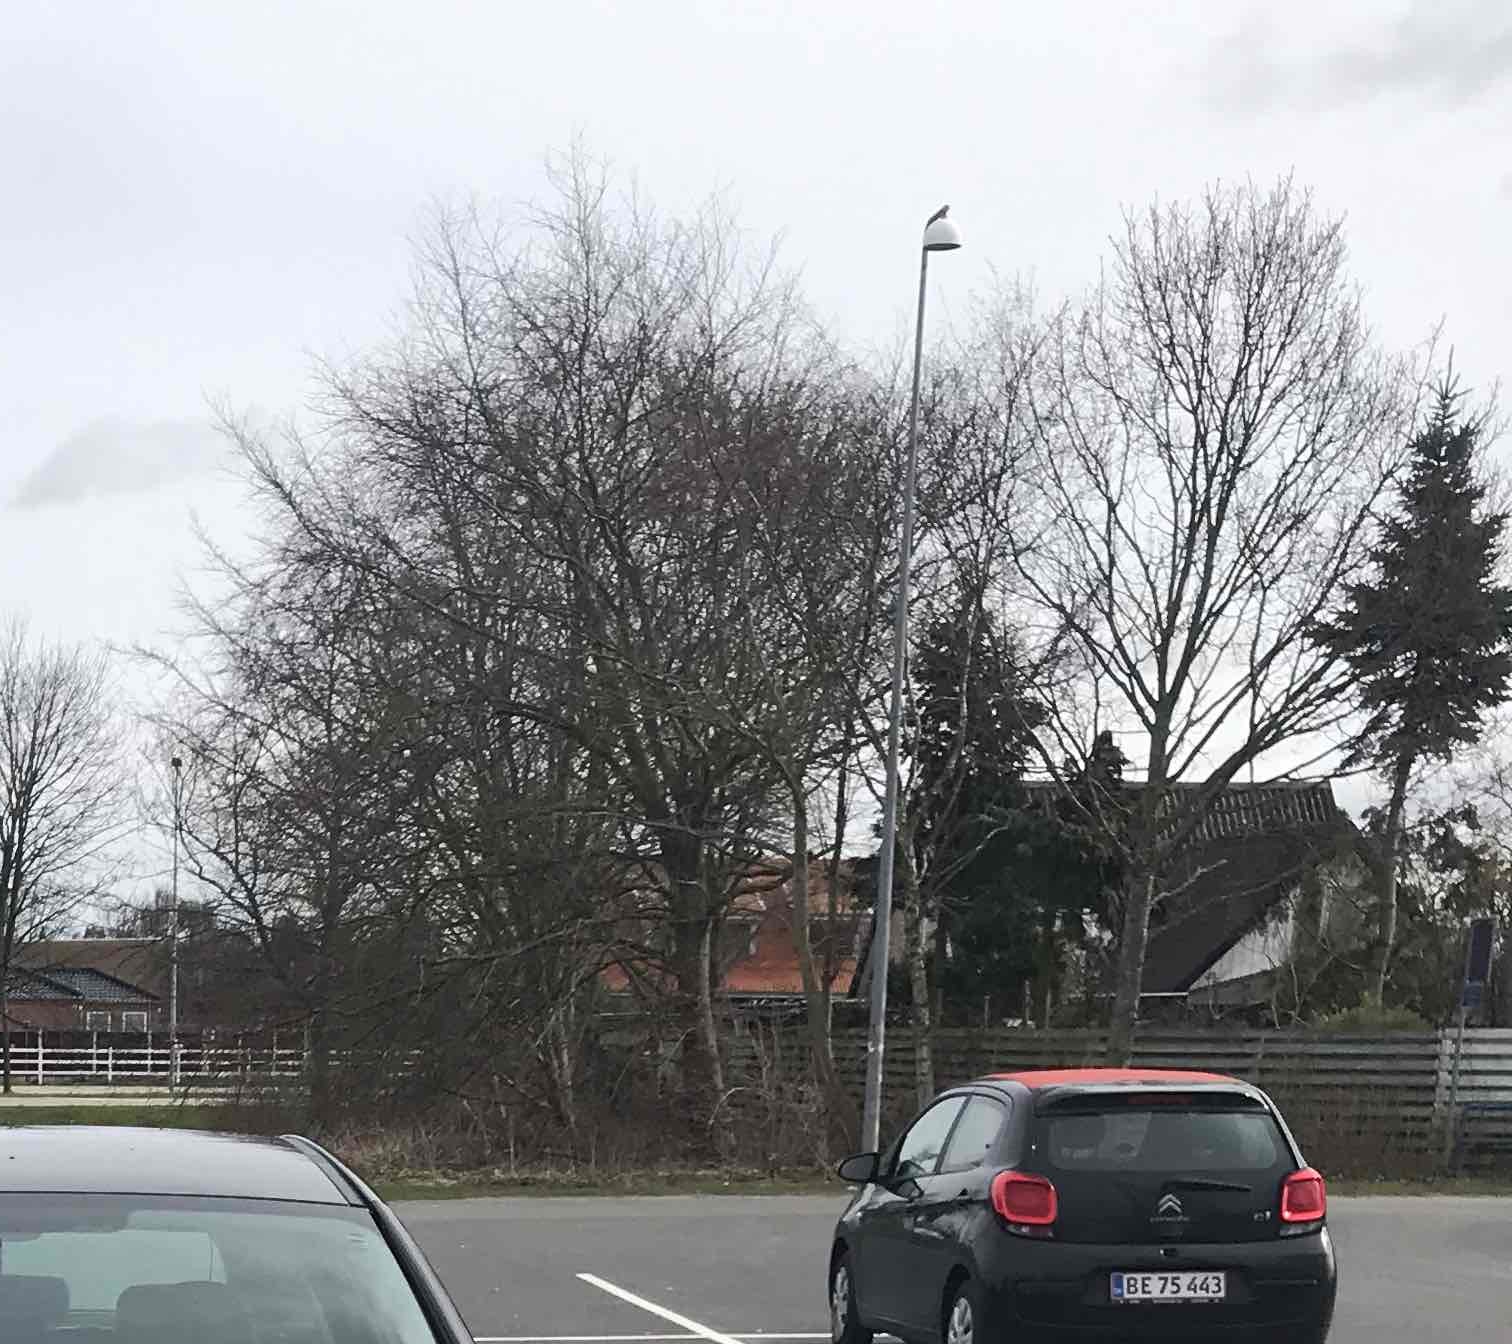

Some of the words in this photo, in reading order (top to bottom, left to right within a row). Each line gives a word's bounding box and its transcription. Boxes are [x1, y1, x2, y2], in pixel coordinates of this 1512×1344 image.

[1126, 1276, 1152, 1295] BE
[1158, 1276, 1181, 1294] 75
[1187, 1276, 1222, 1294] 443
